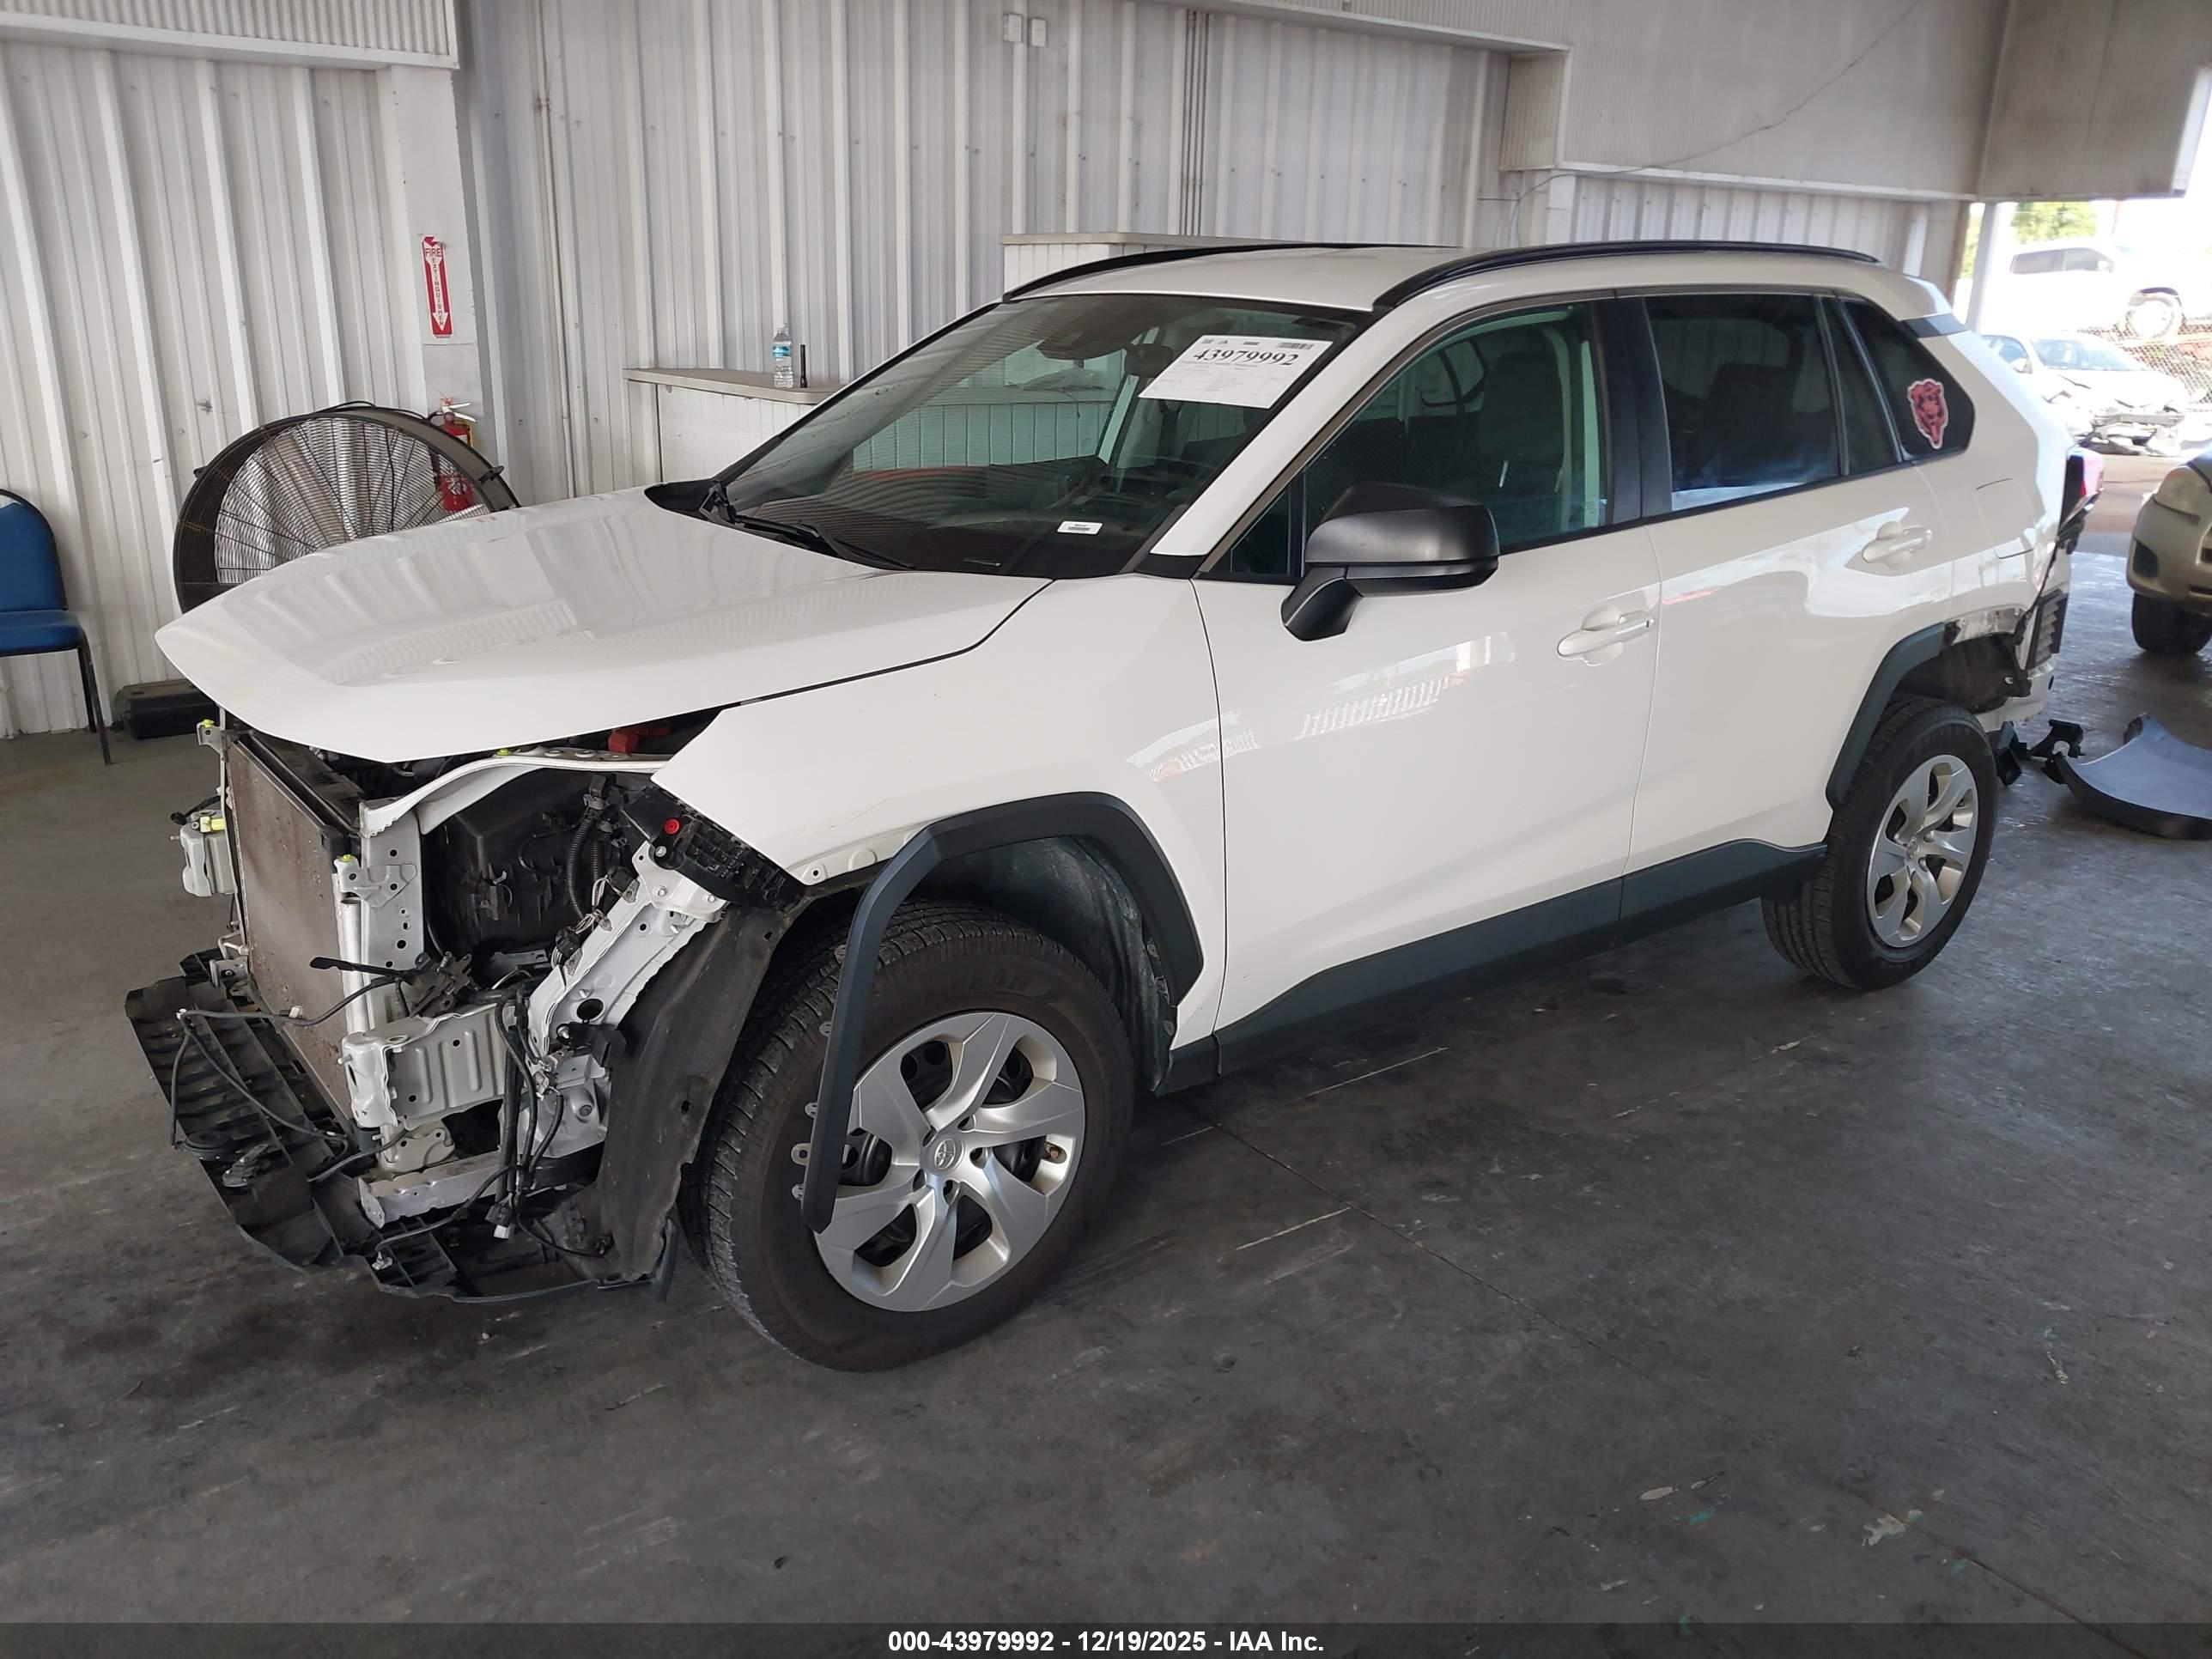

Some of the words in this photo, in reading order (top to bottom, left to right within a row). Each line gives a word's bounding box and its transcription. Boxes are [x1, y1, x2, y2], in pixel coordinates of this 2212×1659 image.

[425, 247, 442, 258] FIRE
[432, 258, 445, 326] EXTINGUISHER
[1194, 348, 1299, 367] 43979992
